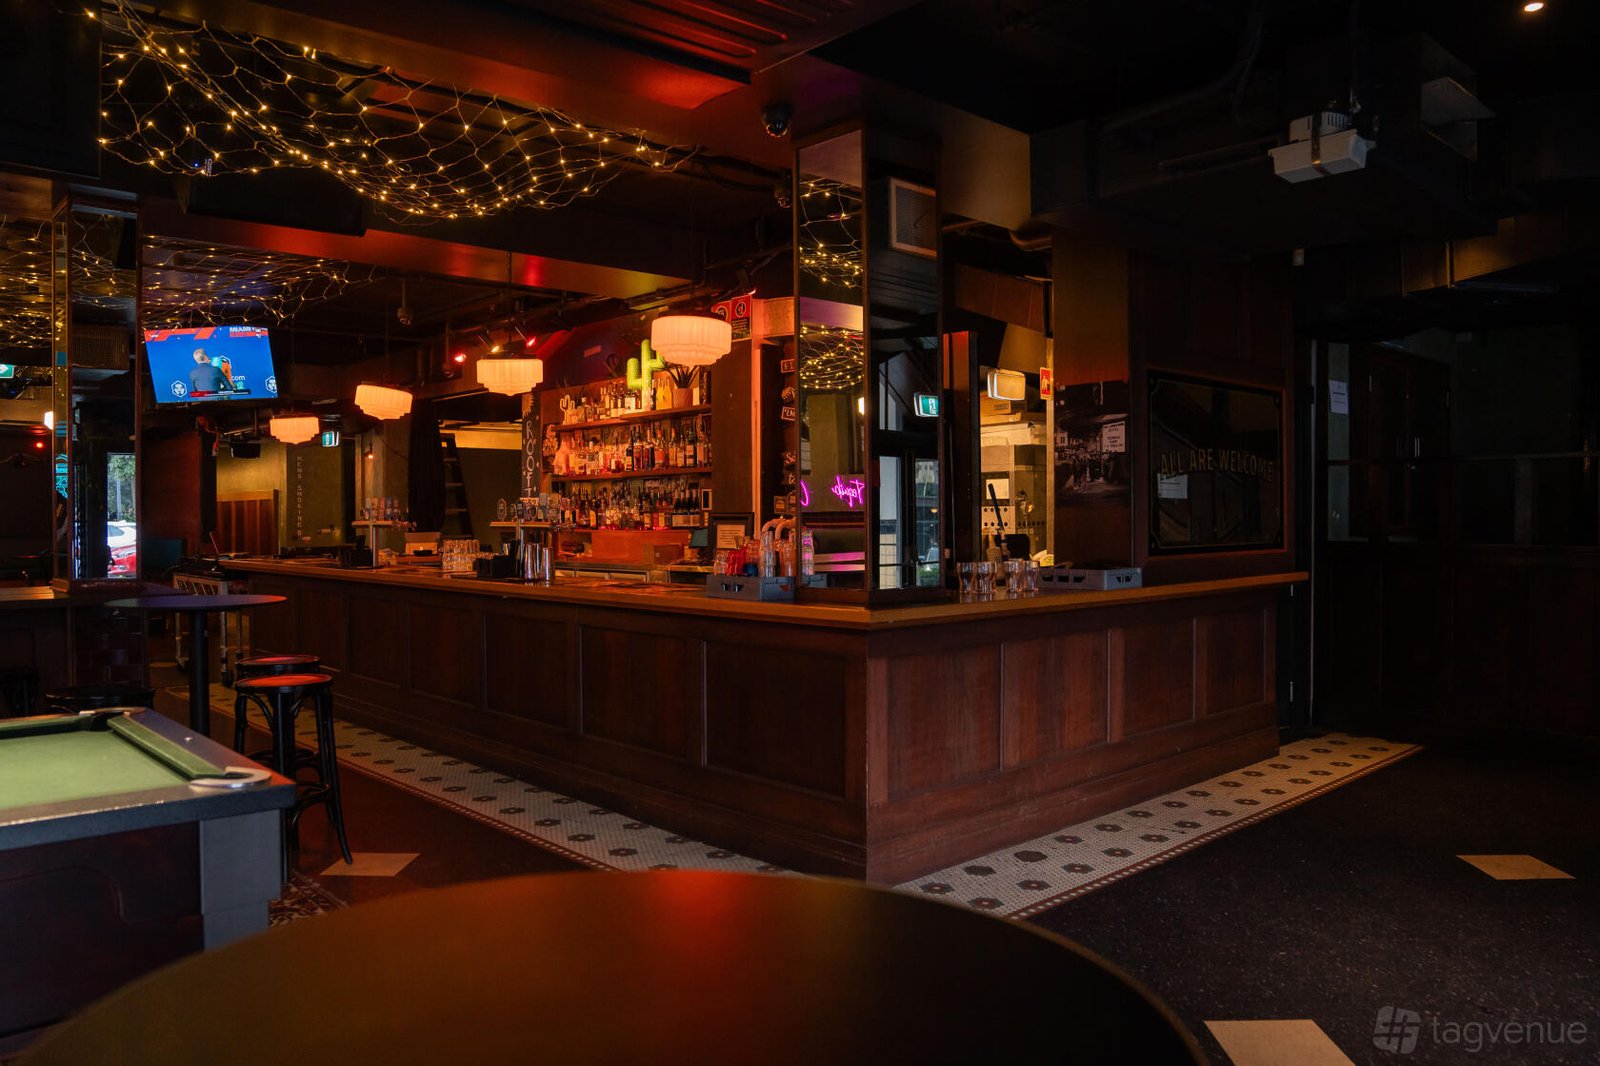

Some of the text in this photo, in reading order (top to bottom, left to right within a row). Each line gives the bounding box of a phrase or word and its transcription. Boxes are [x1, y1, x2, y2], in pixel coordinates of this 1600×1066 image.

[1160, 448, 1273, 483] ALL ARE WELCOME
